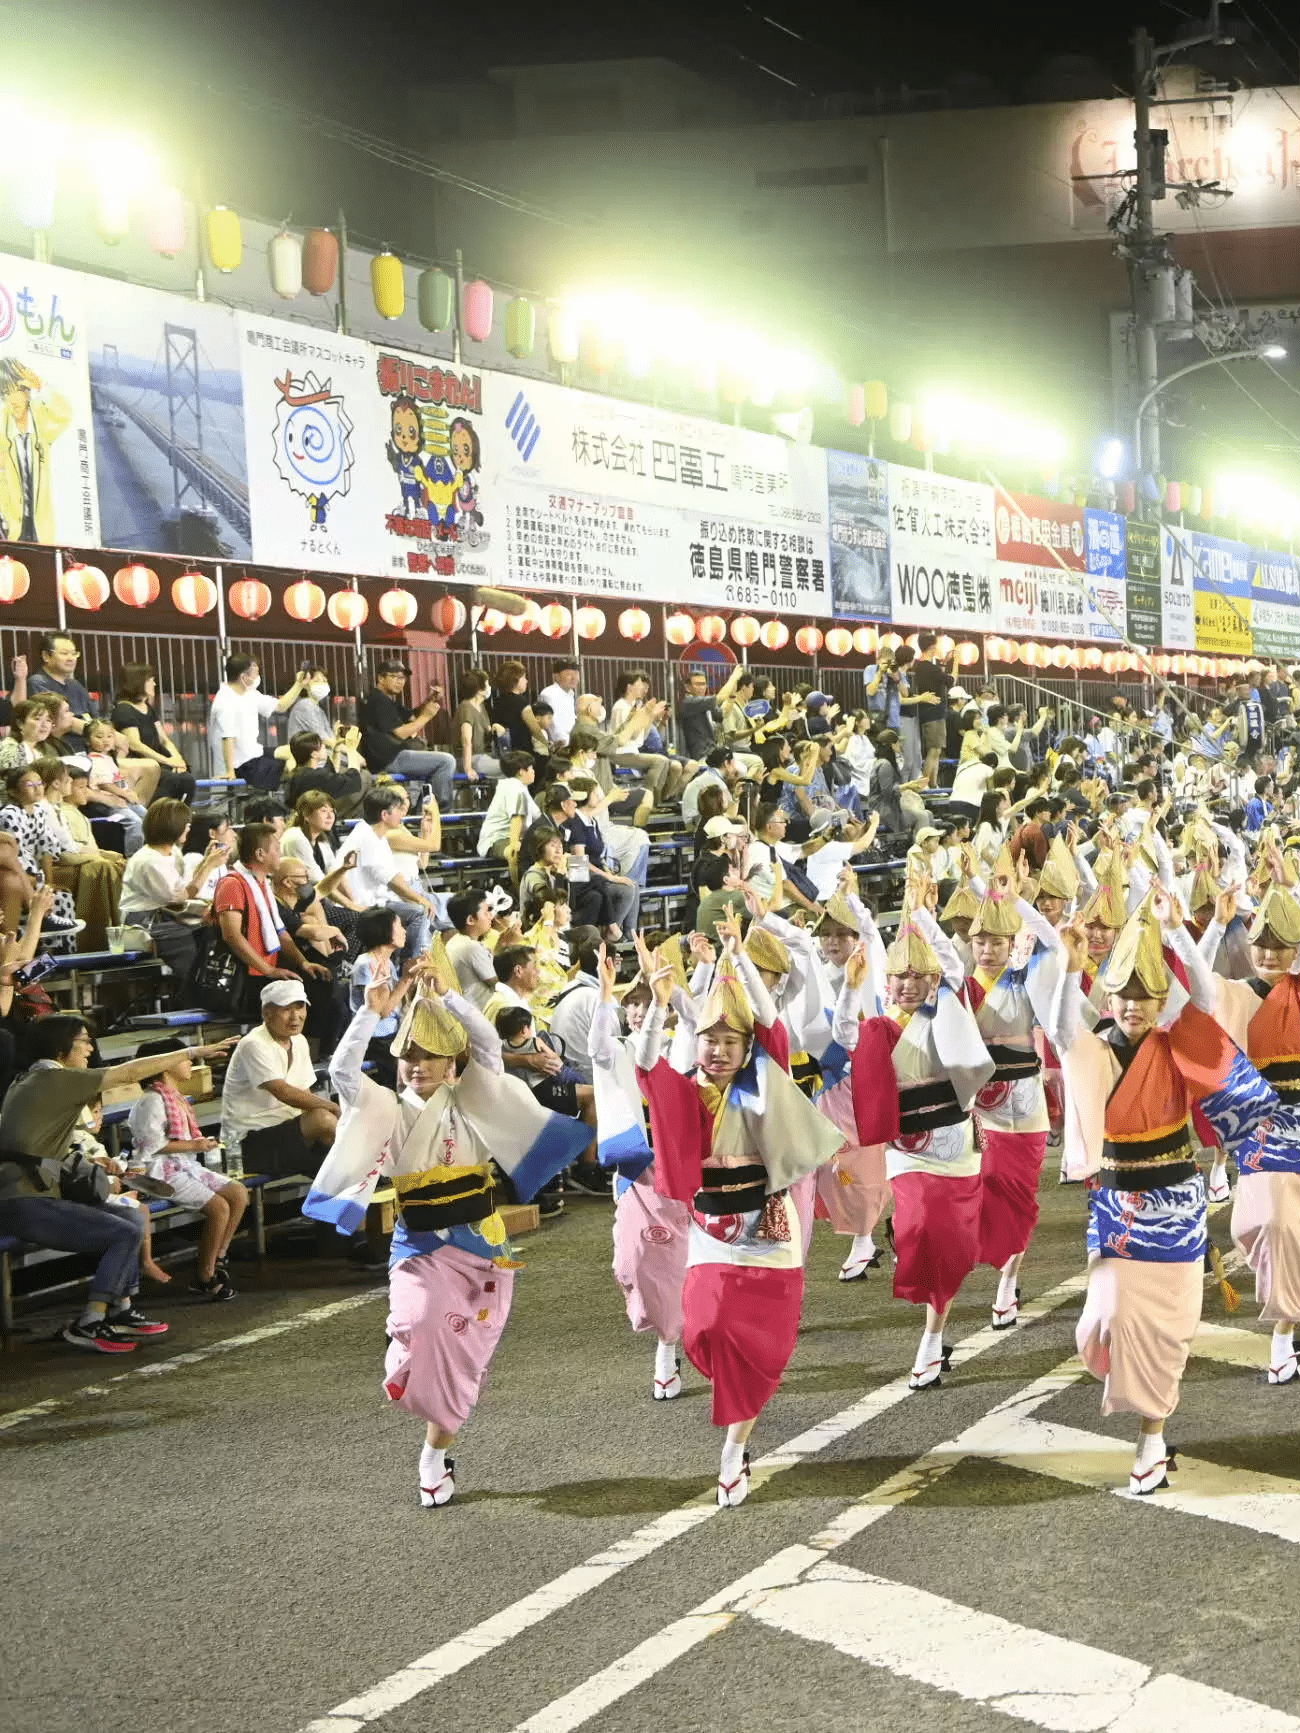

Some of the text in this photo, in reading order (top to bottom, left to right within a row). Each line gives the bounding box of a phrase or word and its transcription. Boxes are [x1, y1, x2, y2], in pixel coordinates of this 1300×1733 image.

[689, 541, 825, 592] 徳島県鳴門警察署
[1000, 571, 1038, 616] meiji
